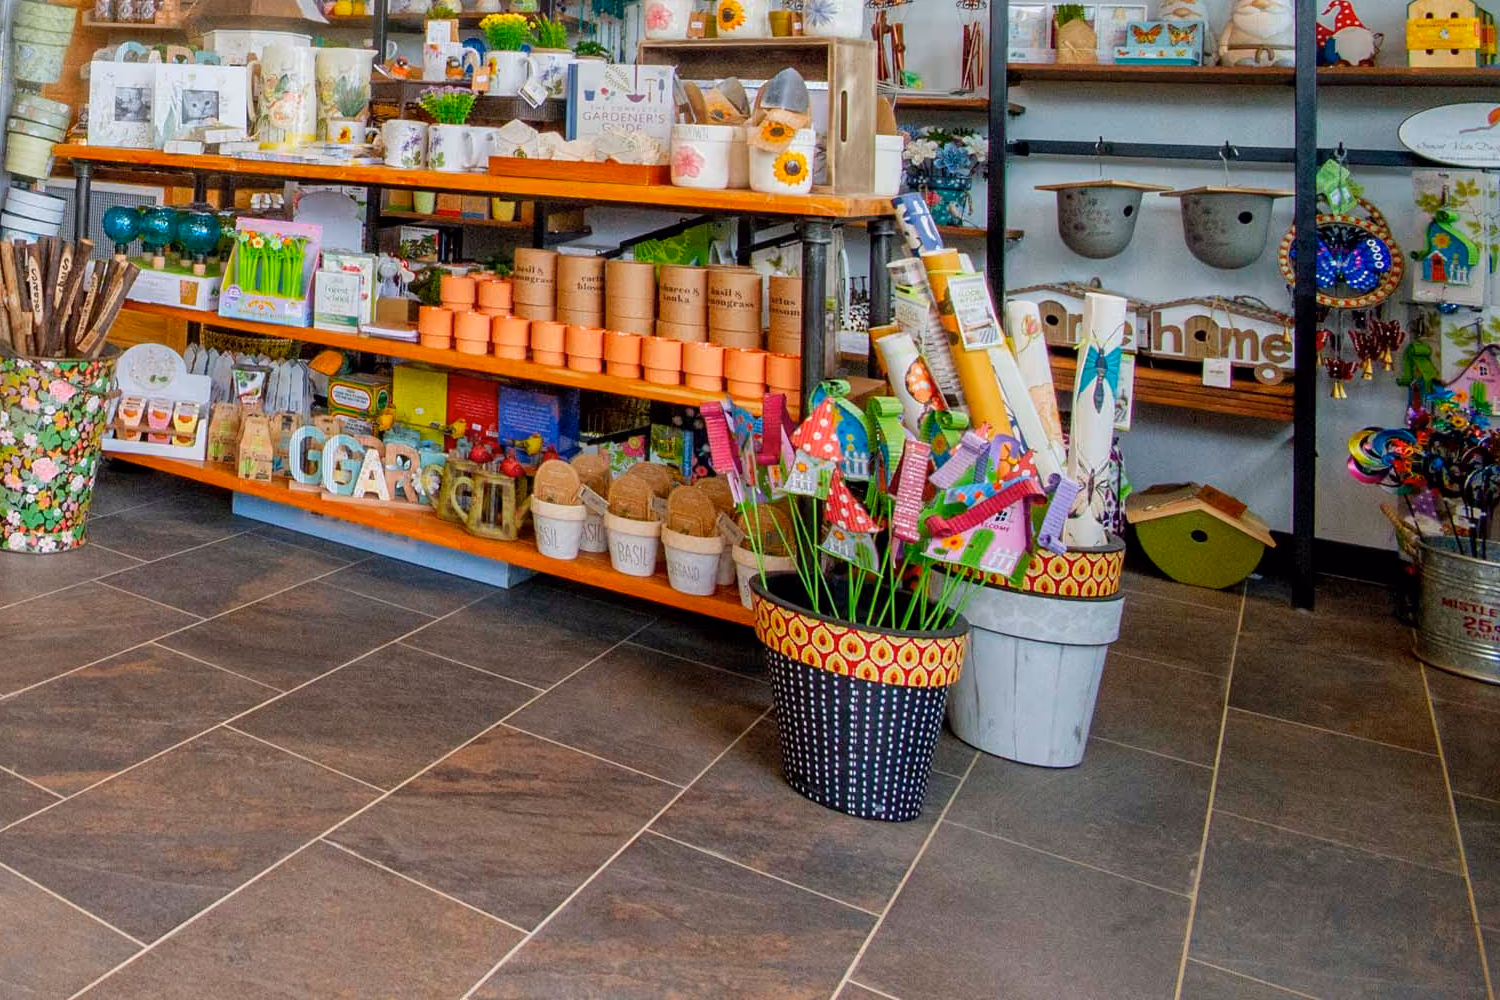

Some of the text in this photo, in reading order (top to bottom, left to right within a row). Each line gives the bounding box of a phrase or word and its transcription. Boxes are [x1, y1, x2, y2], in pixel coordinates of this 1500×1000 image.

[582, 112, 666, 124] GARDENER'S
[660, 284, 691, 294] obacco
[771, 296, 796, 307] actus
[538, 524, 558, 549] ASIL
[581, 523, 602, 543] ASIL
[617, 541, 649, 568] BASIL
[1442, 597, 1498, 618] MISTLE
